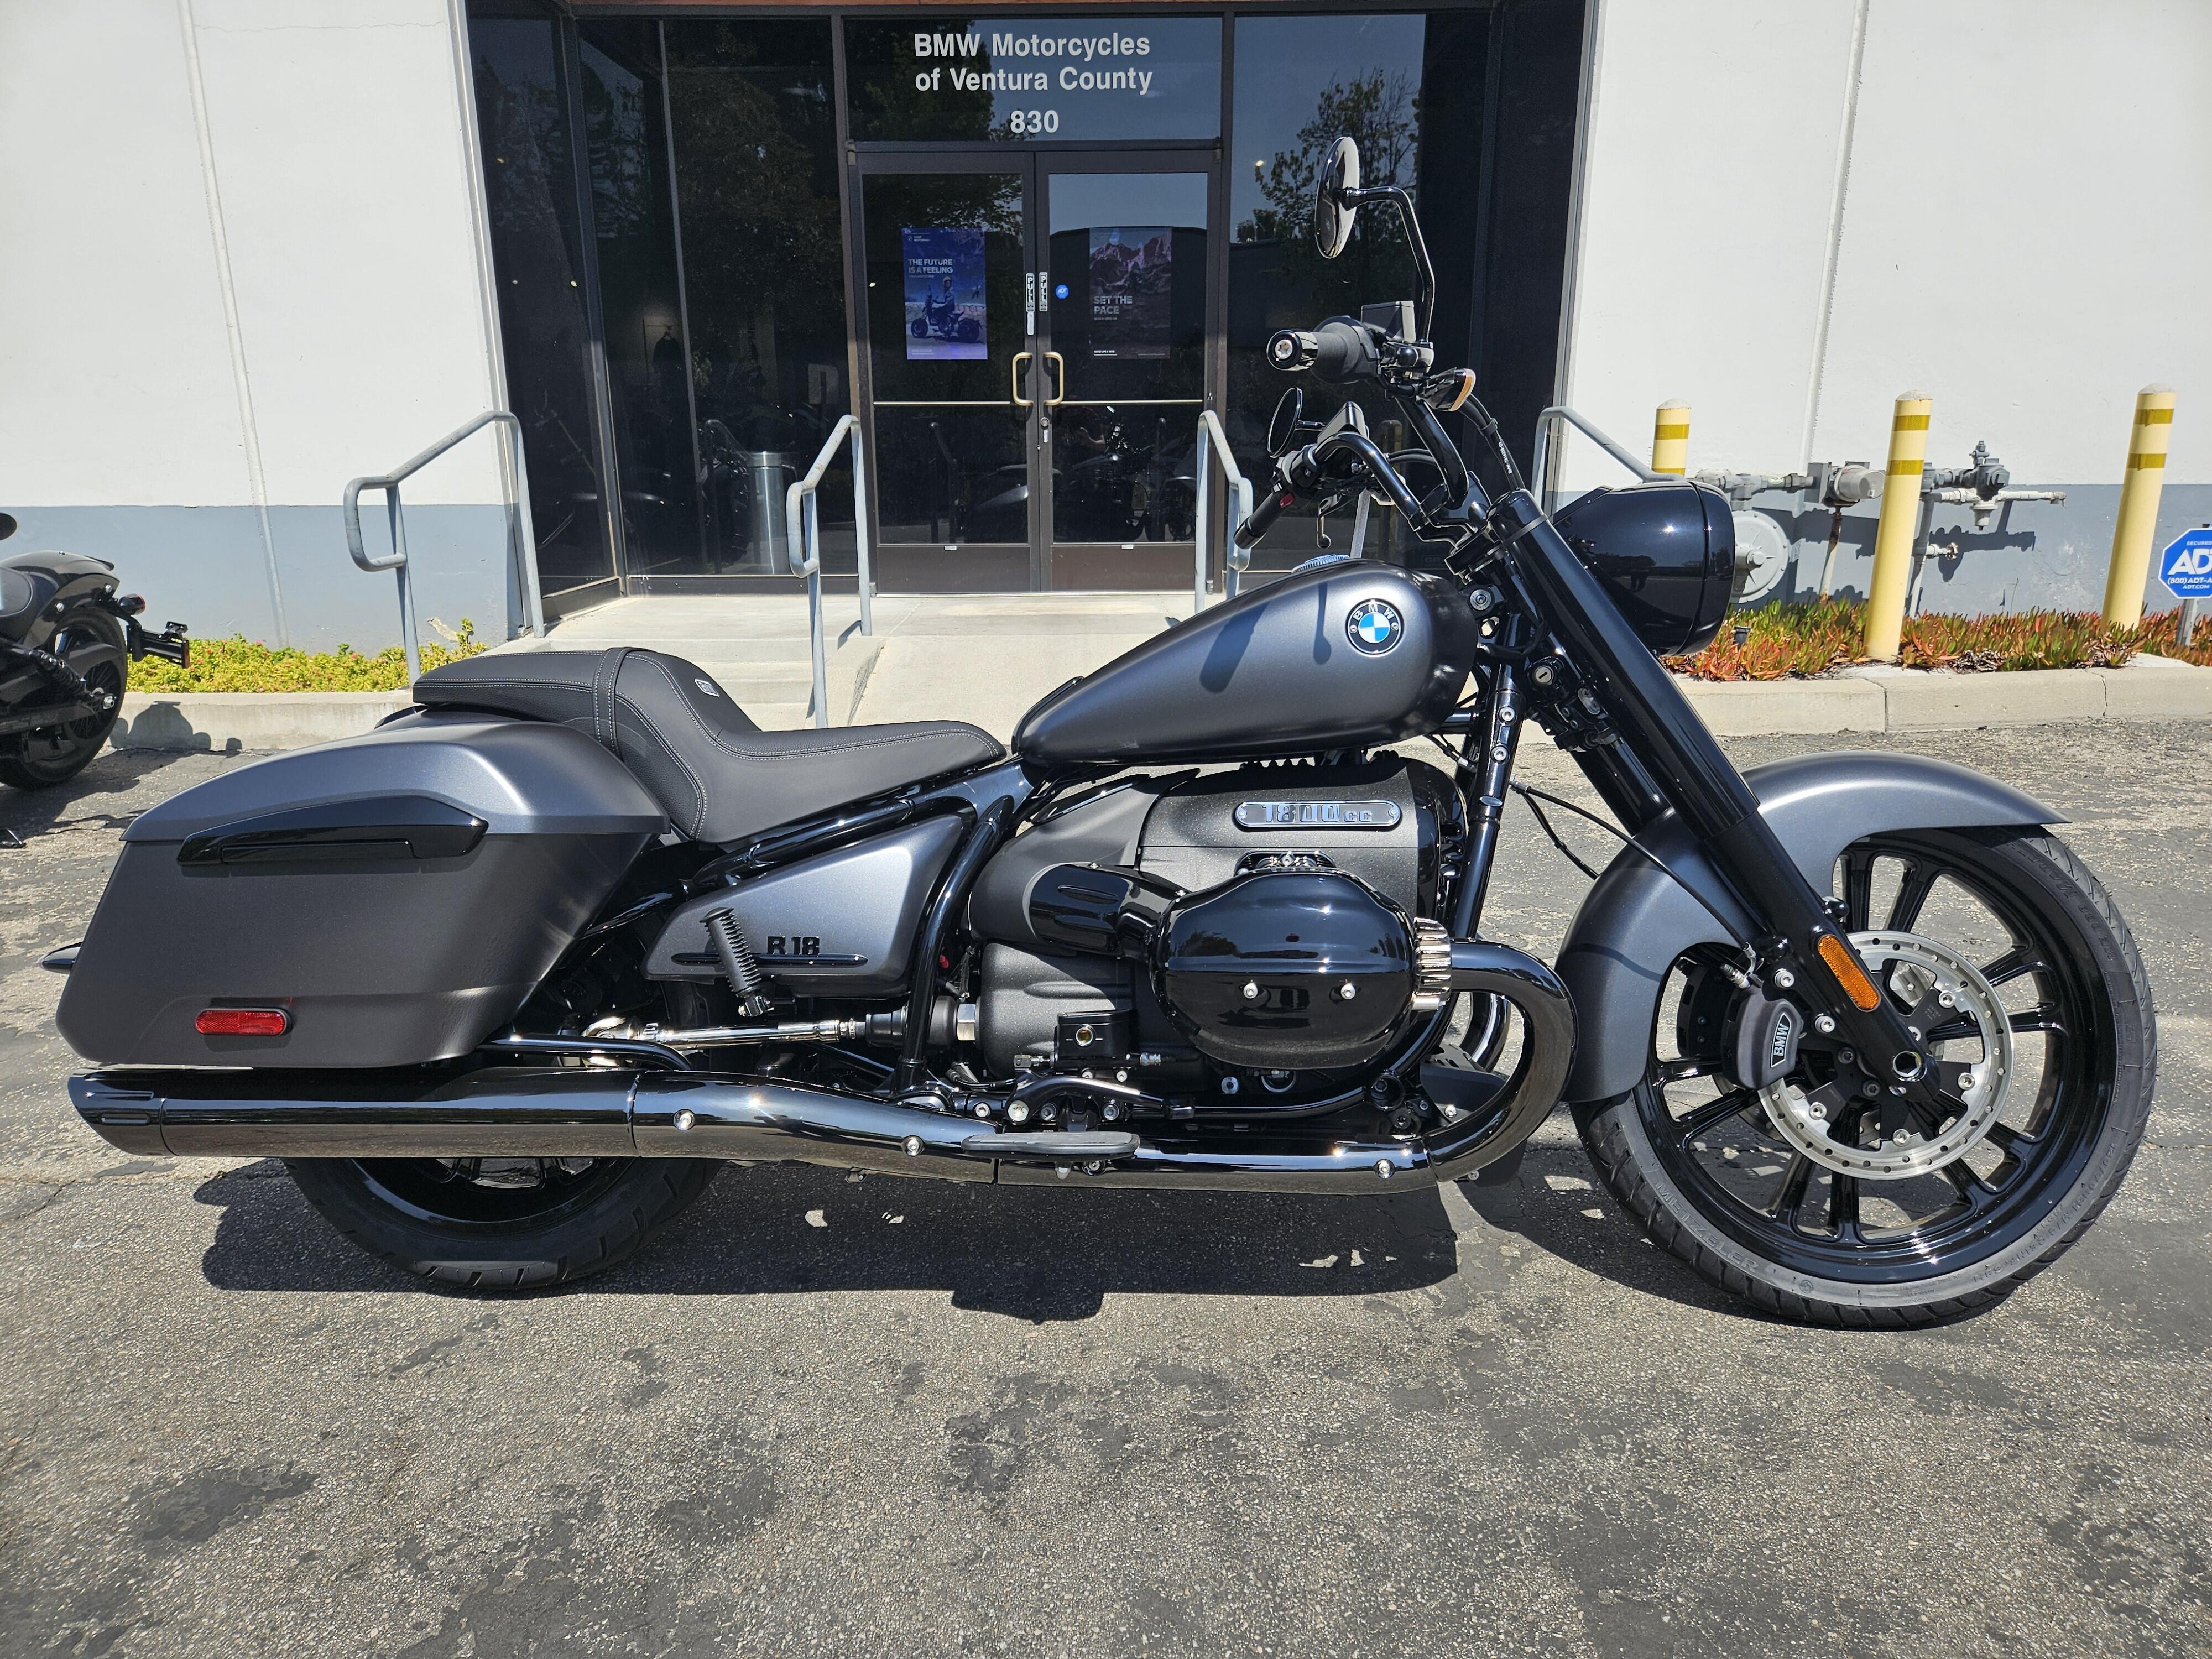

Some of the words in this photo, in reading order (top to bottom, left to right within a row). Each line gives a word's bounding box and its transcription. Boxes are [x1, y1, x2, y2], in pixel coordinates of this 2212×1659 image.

[914, 33, 981, 57] BMW
[992, 32, 1151, 62] Motorcycles
[915, 68, 940, 91] of
[949, 67, 1048, 91] Ventura
[1058, 66, 1153, 95] County
[1010, 110, 1060, 133] 830
[1093, 295, 1112, 304] SET
[1113, 295, 1133, 304] THE
[1093, 306, 1119, 315] PACE
[2167, 548, 2212, 575] AD
[1352, 603, 1395, 622] BMW
[1261, 804, 1373, 823] 1800cc
[766, 936, 787, 956] R
[791, 936, 820, 956] 18
[1773, 1023, 1790, 1057] BMW
[1655, 1181, 1760, 1272] METZELER
